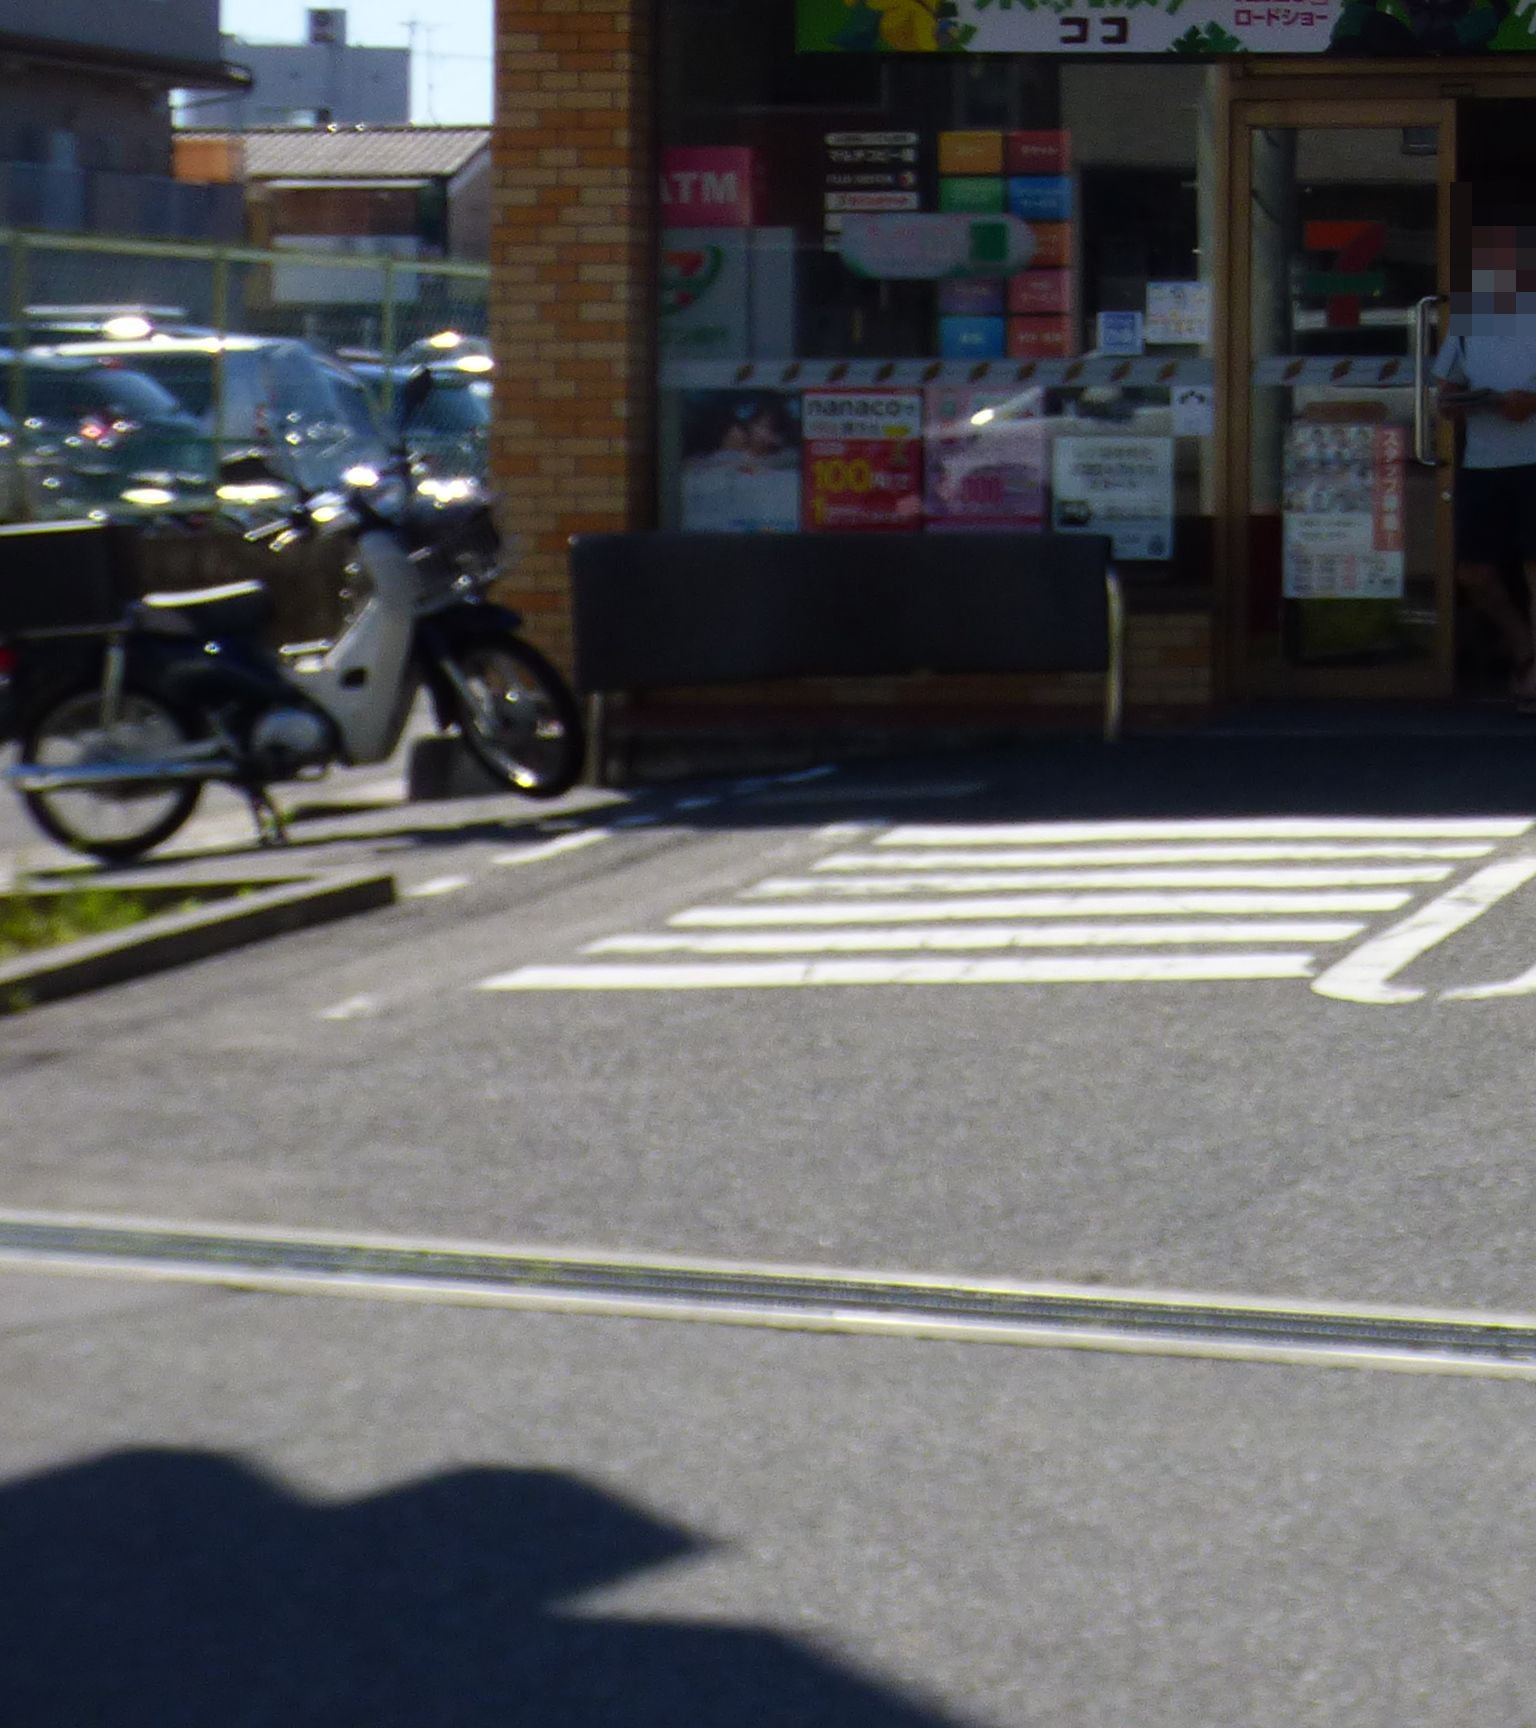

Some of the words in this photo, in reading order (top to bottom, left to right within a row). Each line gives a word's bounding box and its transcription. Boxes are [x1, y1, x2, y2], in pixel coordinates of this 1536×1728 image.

[1234, 8, 1329, 26] ロードショー
[1059, 16, 1129, 44] ココ
